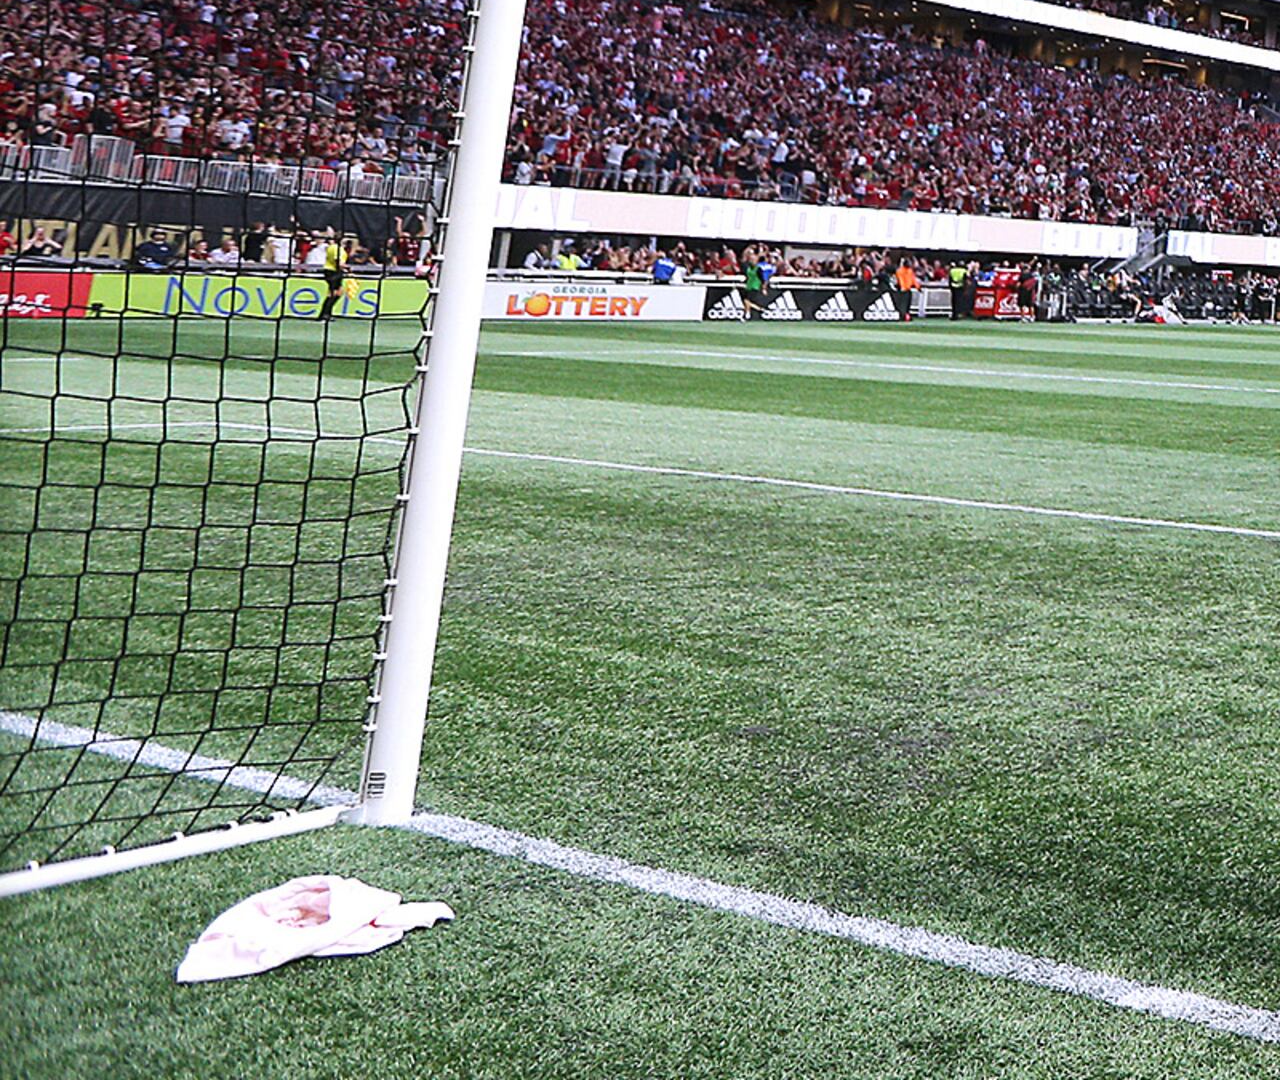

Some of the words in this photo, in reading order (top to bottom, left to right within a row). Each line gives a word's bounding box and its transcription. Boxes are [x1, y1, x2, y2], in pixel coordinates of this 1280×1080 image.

[163, 276, 379, 316] Noveis
[553, 286, 607, 294] GEORGIA
[506, 291, 649, 317] LOTTERY
